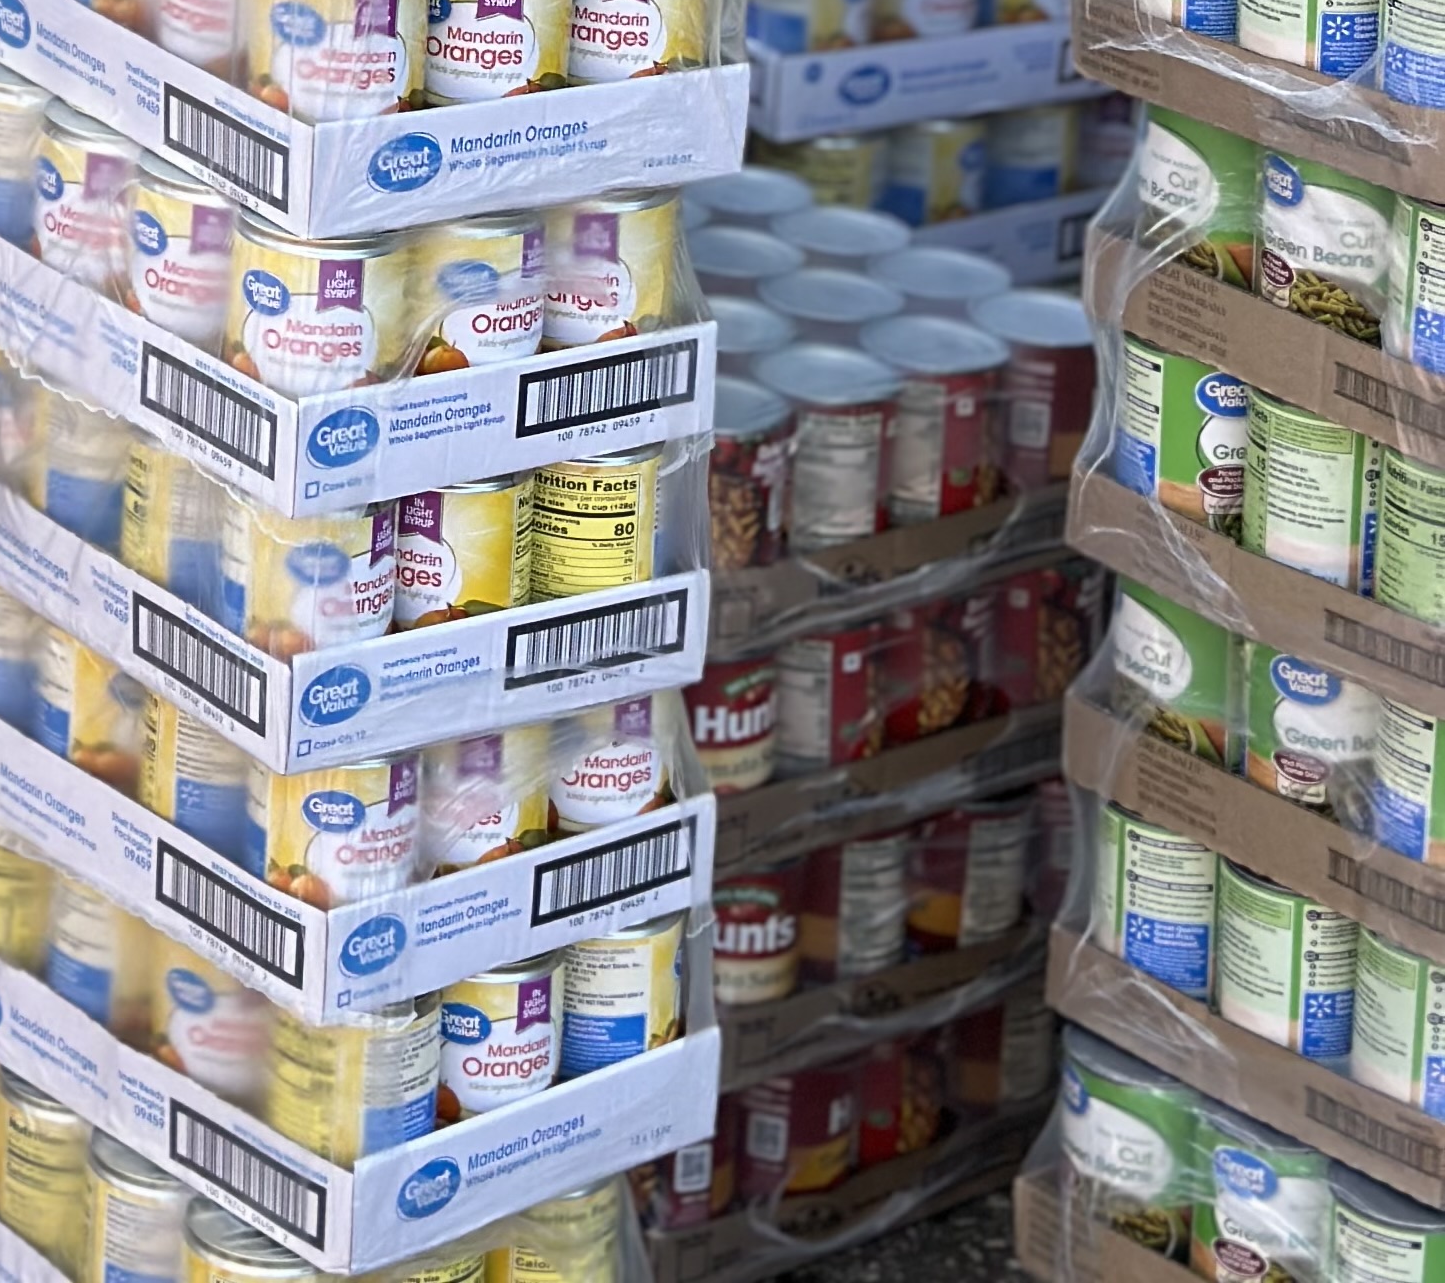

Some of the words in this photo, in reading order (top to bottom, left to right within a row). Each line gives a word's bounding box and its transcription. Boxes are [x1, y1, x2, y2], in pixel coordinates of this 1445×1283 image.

[576, 7, 649, 27] Mandarin
[447, 27, 524, 45] Mandarin
[427, 37, 523, 68] Oranges
[451, 131, 522, 153] Mandarin
[526, 120, 588, 144] Oranges
[377, 147, 430, 169] Great
[390, 164, 428, 182] Value
[1168, 172, 1199, 192] Cut
[1151, 183, 1197, 209] Beans
[1340, 232, 1374, 249] Cut
[286, 317, 363, 337] Mandarin
[262, 329, 363, 360] Oranges
[389, 412, 444, 432] Mandarin
[444, 402, 491, 424] Oranges
[316, 421, 368, 448] Great
[389, 432, 412, 444] Whole
[414, 426, 452, 441] Segments
[556, 429, 574, 442] 100
[579, 424, 607, 438] 78742
[613, 417, 640, 430] 09459
[650, 414, 656, 423] 2
[328, 438, 367, 456] Value
[593, 478, 637, 491] Facts
[589, 502, 606, 512] cup
[614, 521, 634, 535] 80
[435, 656, 480, 676] Oranges
[1141, 645, 1172, 668] Cut
[1277, 662, 1328, 686] Great
[309, 680, 359, 706] Great
[1288, 680, 1328, 696] Value
[320, 697, 358, 714] Value
[313, 741, 336, 751] Case
[585, 750, 651, 768] Mandarin
[309, 797, 355, 817] Great
[124, 848, 152, 872] 09459
[348, 926, 397, 954] Great
[359, 944, 395, 965] Value
[462, 1050, 550, 1079] Oranges
[467, 1132, 528, 1171] Mandarin
[532, 1113, 586, 1145] Oranges
[1117, 1146, 1154, 1165] Cut
